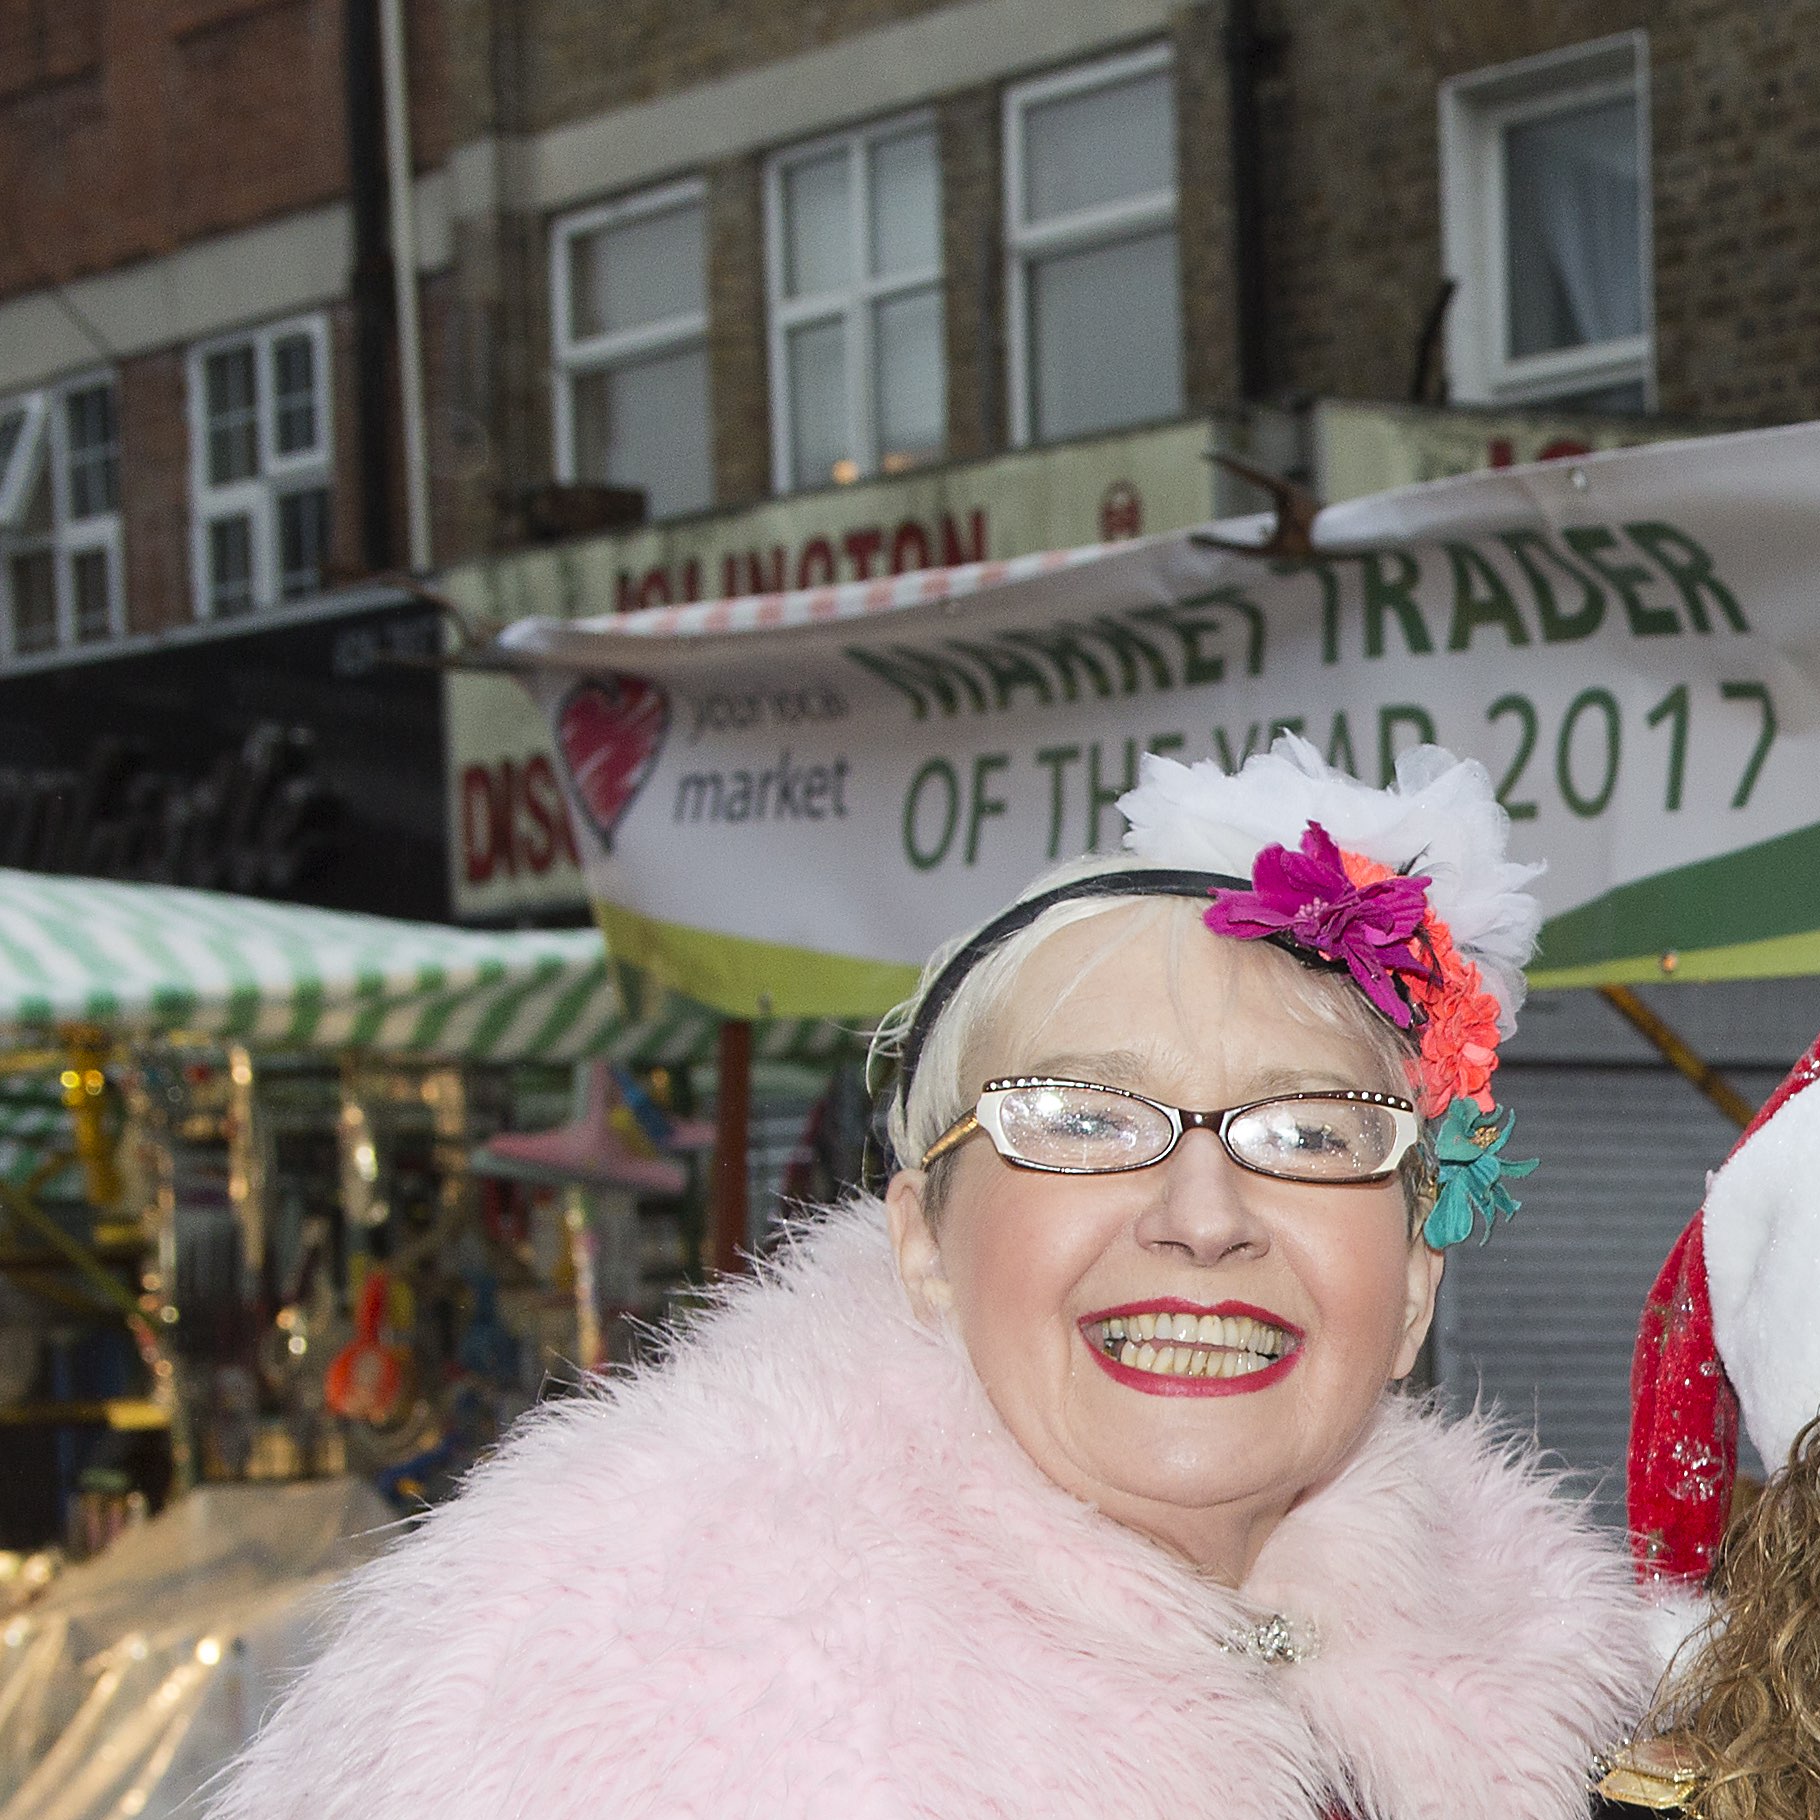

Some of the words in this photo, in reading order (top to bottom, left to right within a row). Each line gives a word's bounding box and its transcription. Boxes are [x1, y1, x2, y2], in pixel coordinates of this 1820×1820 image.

[842, 584, 1265, 720] MARKET
[1270, 520, 1750, 664] TRADER
[672, 750, 851, 823] market
[904, 754, 1010, 872] OF
[1036, 730, 1185, 861] TH
[1210, 702, 1438, 792] YAR
[1487, 682, 1778, 820] 2017
